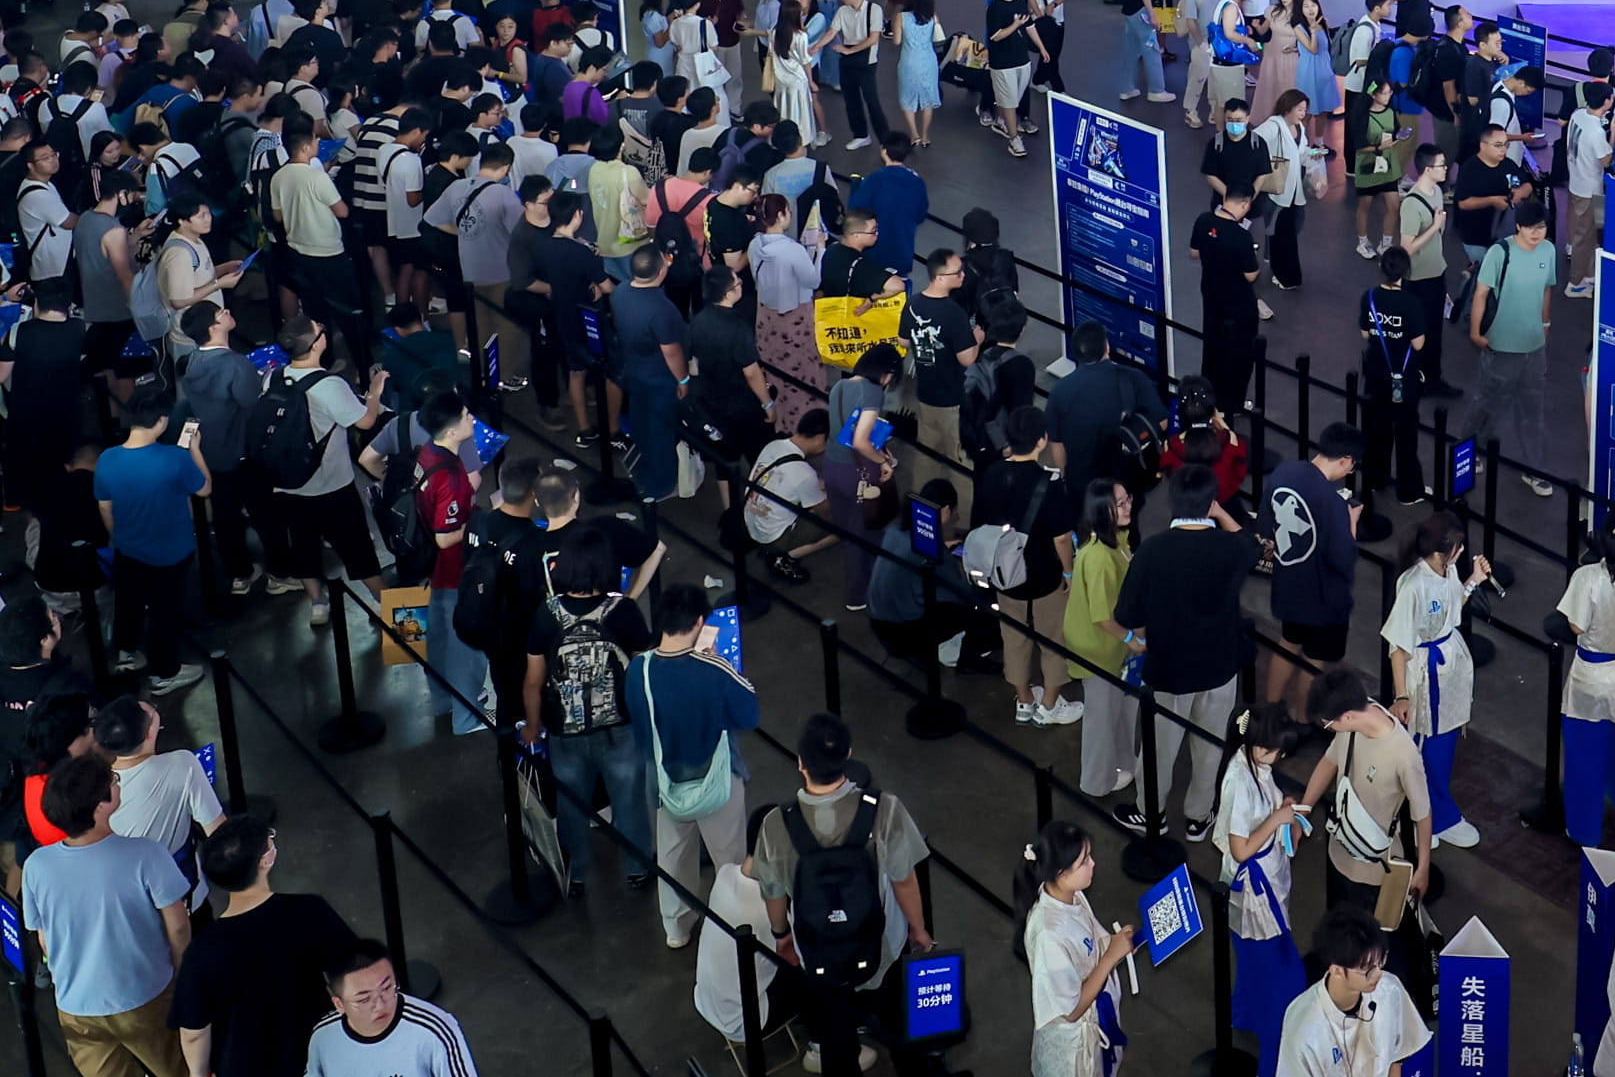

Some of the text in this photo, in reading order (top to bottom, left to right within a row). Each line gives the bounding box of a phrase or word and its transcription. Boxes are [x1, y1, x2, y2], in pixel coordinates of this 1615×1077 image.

[918, 983, 951, 995] 预计等待
[917, 993, 953, 1008] 30分钟
